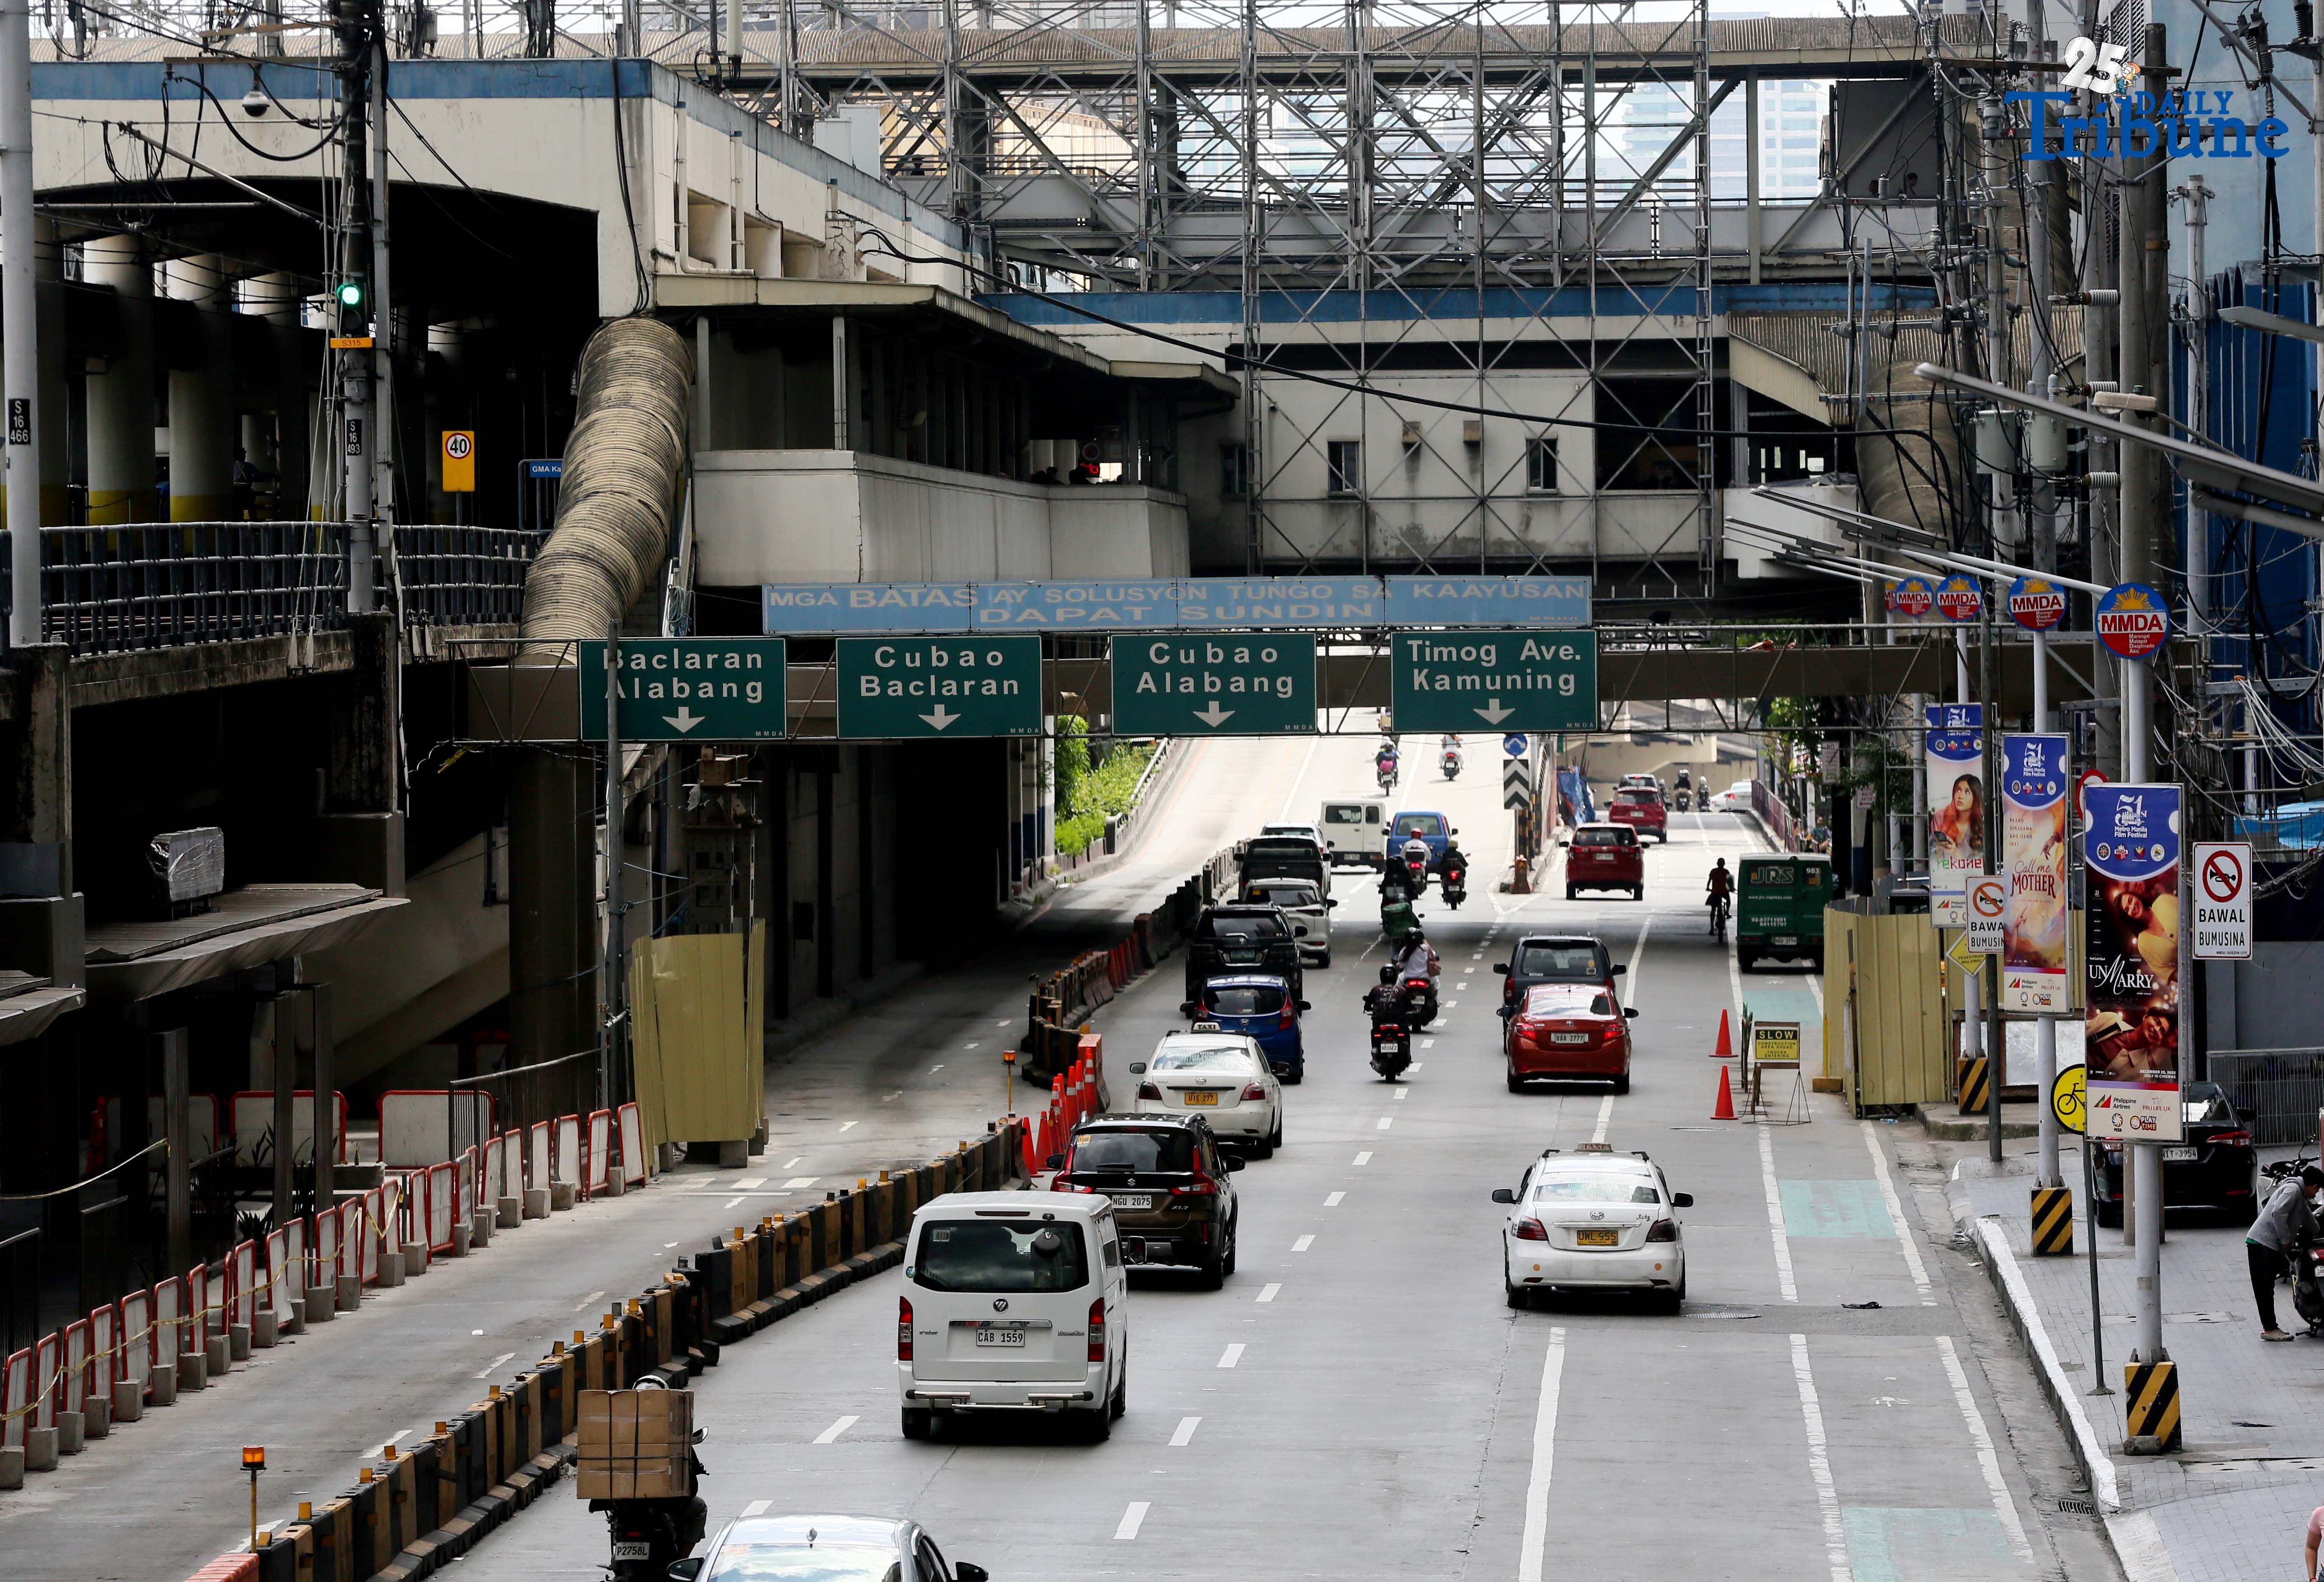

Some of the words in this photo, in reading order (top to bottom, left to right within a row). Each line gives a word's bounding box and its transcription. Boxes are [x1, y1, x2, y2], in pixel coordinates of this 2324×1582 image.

[15, 400, 22, 414] S
[13, 415, 24, 428] 16
[350, 422, 355, 431] S
[10, 429, 28, 442] 466
[349, 433, 357, 443] 16
[347, 444, 360, 453] 493
[450, 438, 468, 453] 40
[771, 591, 838, 606] MGA
[850, 588, 979, 607] BATAS
[993, 590, 1024, 603] AY
[1045, 586, 1207, 603] SOLUSYON
[1226, 585, 1332, 600] TUNGO
[1352, 584, 1392, 599] SA
[1413, 583, 1584, 599] KAAYUSAN
[1899, 594, 1930, 602] MMDA
[1939, 593, 1978, 605] MMDA
[2013, 595, 2062, 611] MMDA
[980, 607, 1154, 623] DAPAT
[1180, 602, 1372, 620] SUNDIN
[2102, 614, 2163, 632] MMDA
[603, 649, 764, 670] Baclaran
[875, 646, 1004, 668] Cubao
[1149, 642, 1279, 664] Cubao
[1408, 639, 1497, 667] Timog
[1520, 639, 1582, 661] Ave.
[861, 675, 1019, 697] Baclaran
[1136, 672, 1293, 699] Alabang
[1413, 668, 1576, 696] Kamuning
[2015, 858, 2036, 874] Call
[2037, 864, 2052, 873] me
[1751, 867, 1794, 884] JRS
[2010, 873, 2057, 899] MOTHER
[2199, 909, 2245, 922] BAWAL
[1971, 922, 2004, 931] BAWA
[1971, 937, 2004, 947] BUMUSIN
[2200, 932, 2245, 946] BUMUSINA
[1759, 1031, 1794, 1039] SLOW
[2179, 1149, 2196, 1158] 3954
[1579, 1232, 1596, 1240] UWL
[1598, 1232, 1616, 1240] 955
[978, 1333, 995, 1343] CAB
[1001, 1333, 1023, 1343] 1559
[617, 1545, 648, 1556] P2758L
